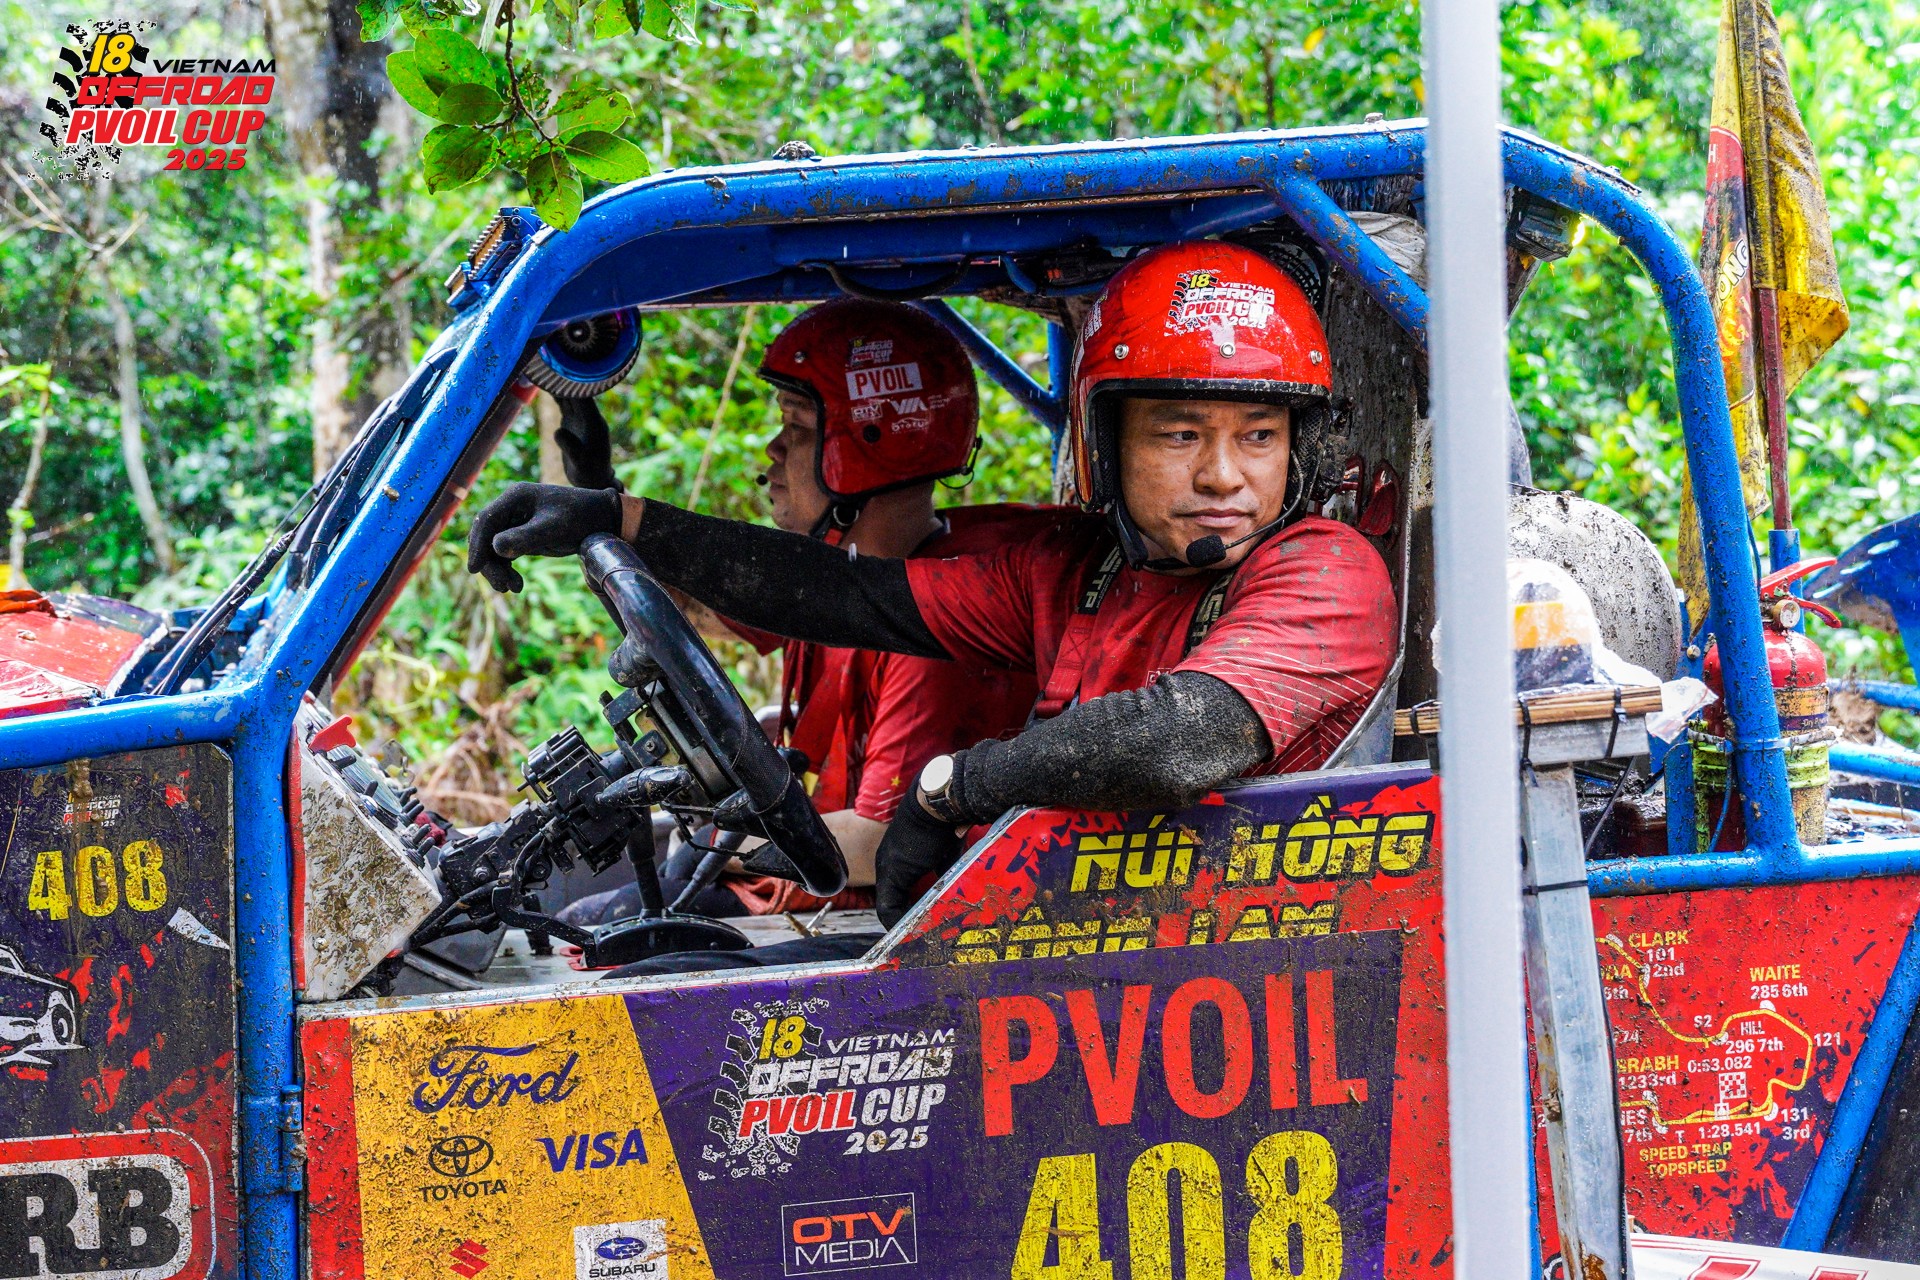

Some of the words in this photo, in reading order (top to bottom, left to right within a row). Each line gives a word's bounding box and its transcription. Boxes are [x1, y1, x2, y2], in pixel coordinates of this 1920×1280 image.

[1190, 273, 1211, 289] 18
[1220, 281, 1275, 294] VIETNAM
[1185, 287, 1275, 305] OFFROAD
[1184, 301, 1231, 317] PVOIL
[1230, 316, 1267, 329] 2025
[854, 367, 914, 395] PVOIL
[1070, 814, 1197, 893] NÚI
[1226, 795, 1429, 882] HỒNG
[27, 840, 169, 921] 408
[1628, 930, 1689, 948] CLARK
[1647, 947, 1675, 962] 101
[1653, 962, 1685, 977] 2nd
[1749, 964, 1801, 982] WAITE
[1750, 984, 1780, 999] 285
[1782, 982, 1808, 998] 6th
[1694, 1015, 1712, 1028] S2
[1740, 1021, 1765, 1036] HILL
[757, 1016, 808, 1060] 18
[826, 1028, 956, 1055] VIETNAM
[1725, 1039, 1755, 1054] 296
[1757, 1037, 1784, 1052] 7th
[1814, 1032, 1841, 1047] 121
[978, 969, 1368, 1137] PVOIL
[412, 1044, 580, 1114] Ford
[748, 1046, 955, 1096] OFFROAD
[737, 1090, 857, 1138] PVOIL
[861, 1083, 946, 1126] CUP
[1781, 1107, 1809, 1122] 131
[1624, 1128, 1653, 1143] 7th
[1675, 1130, 1685, 1144] T
[1699, 1122, 1761, 1139] 1:28.541
[1782, 1126, 1810, 1140] 3rd
[843, 1125, 929, 1156] 2025
[536, 1129, 648, 1173] VISA
[1639, 1145, 1688, 1162] SPEED
[1692, 1142, 1733, 1157] TRAP
[1649, 1159, 1727, 1178] TOPSPEED
[418, 1179, 507, 1202] TOYOTA
[1010, 1130, 1343, 1280] 408
[793, 1209, 911, 1245] OTV
[795, 1237, 910, 1266] MEDIA
[589, 1263, 656, 1278] SUBARU
